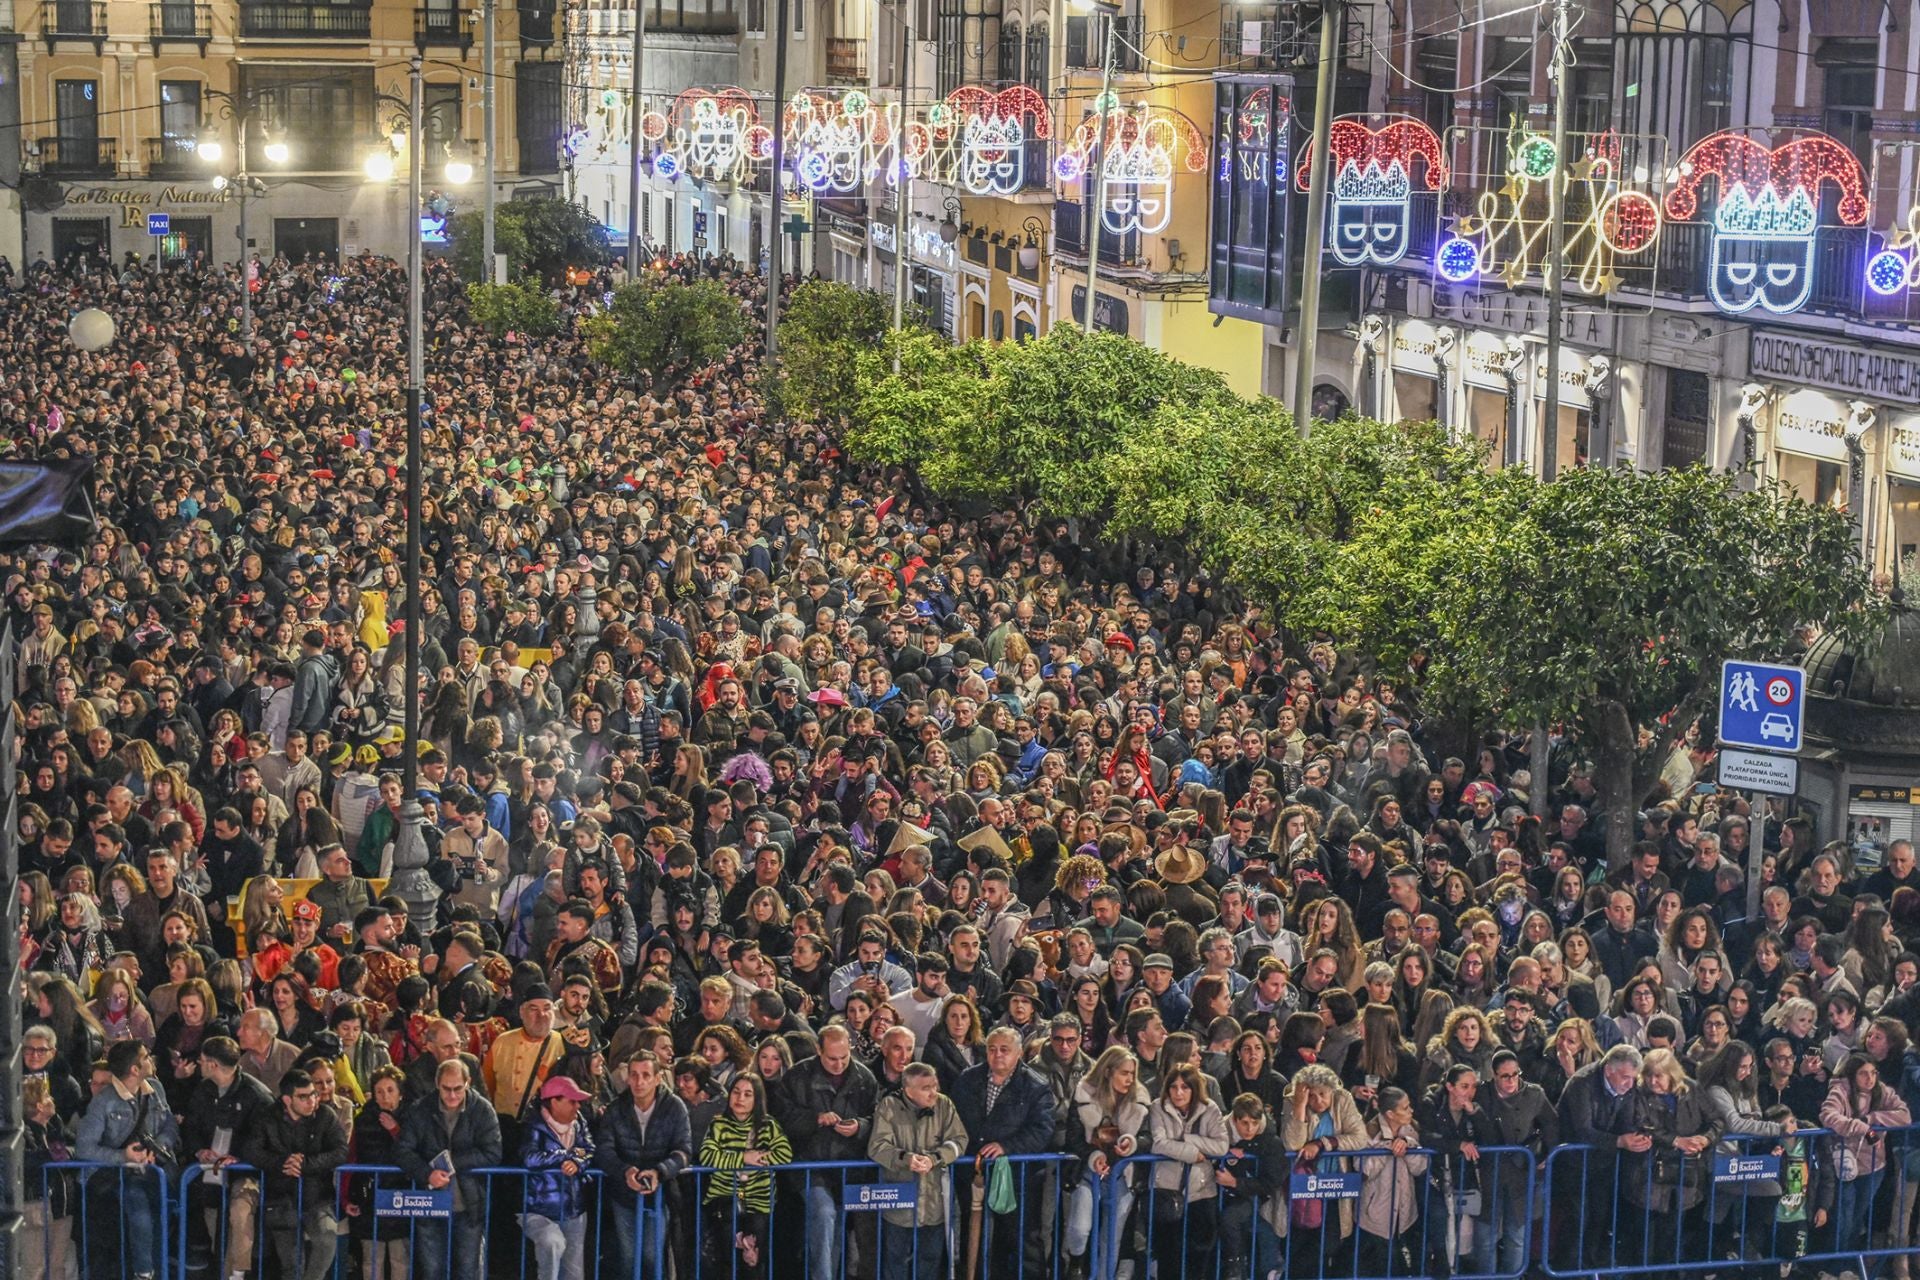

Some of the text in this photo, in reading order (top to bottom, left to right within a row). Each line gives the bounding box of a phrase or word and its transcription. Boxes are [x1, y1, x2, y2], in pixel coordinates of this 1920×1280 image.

[64, 186, 231, 207] La Botica Natural
[1752, 336, 1801, 377] COLEGIO
[1804, 345, 1847, 386] OFICIAL
[1850, 352, 1864, 388] DE
[1772, 686, 1788, 697] 20
[1744, 759, 1772, 768] CALZADA
[1728, 766, 1768, 775] PLATAFORMA
[1724, 774, 1791, 787] PRIORIDAD PEATONAL
[1318, 1182, 1344, 1190] Badajoz
[404, 1199, 432, 1207] Badajoz
